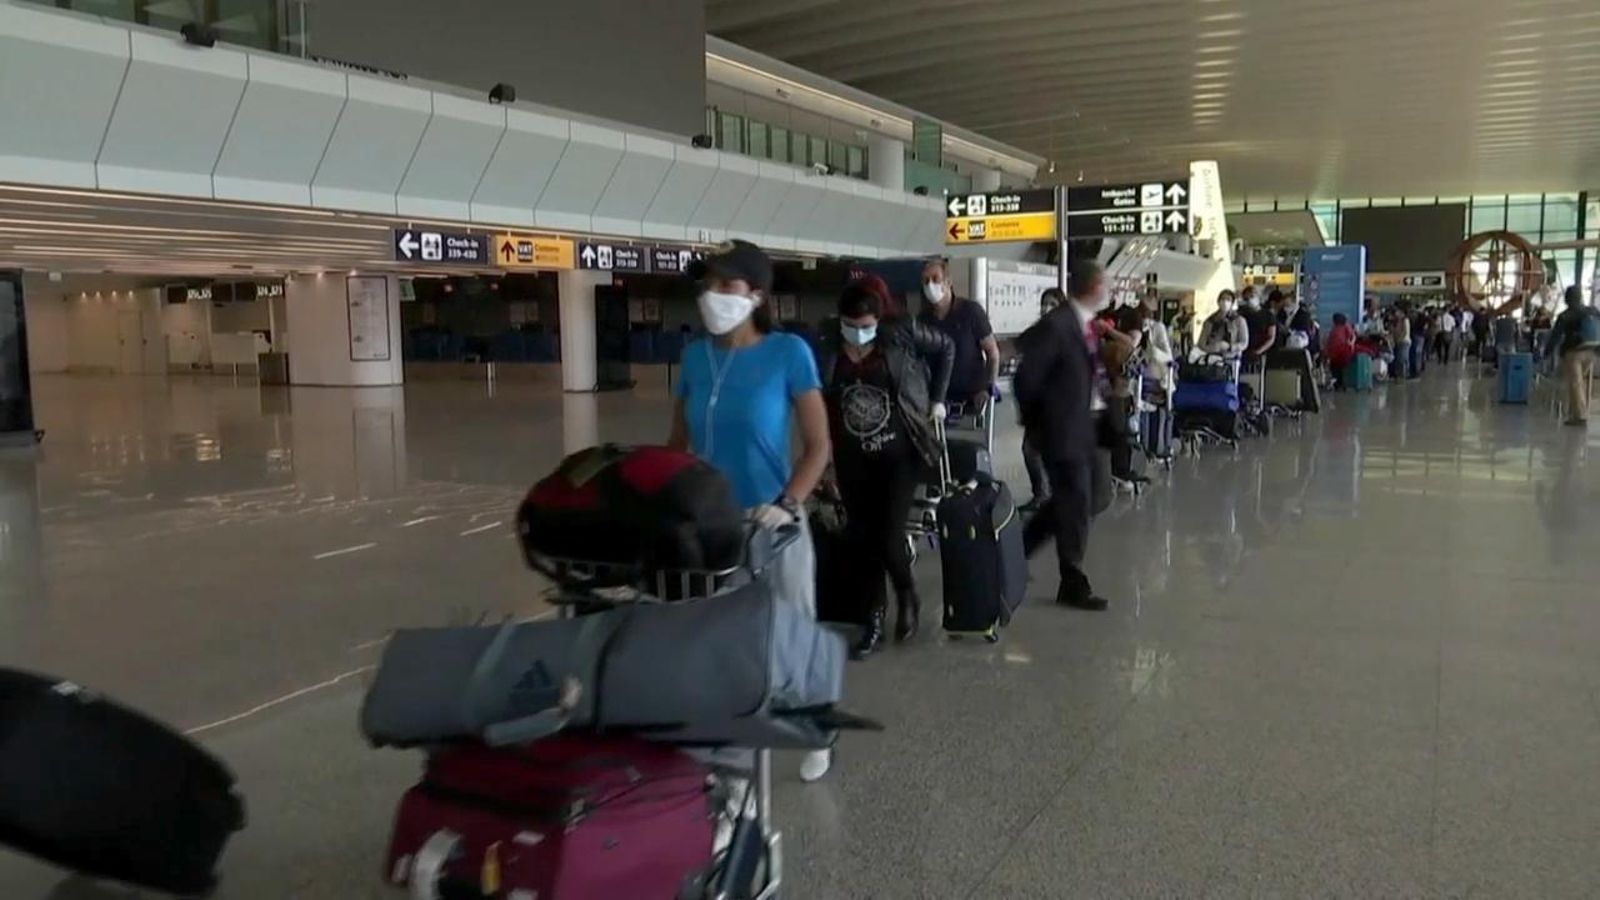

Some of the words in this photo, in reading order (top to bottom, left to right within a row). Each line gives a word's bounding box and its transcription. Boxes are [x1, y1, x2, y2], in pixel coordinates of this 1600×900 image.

[991, 194, 1021, 204] Check-in
[1113, 198, 1136, 206] Gates
[1101, 215, 1136, 224] Check-in
[447, 237, 479, 249] Check-in
